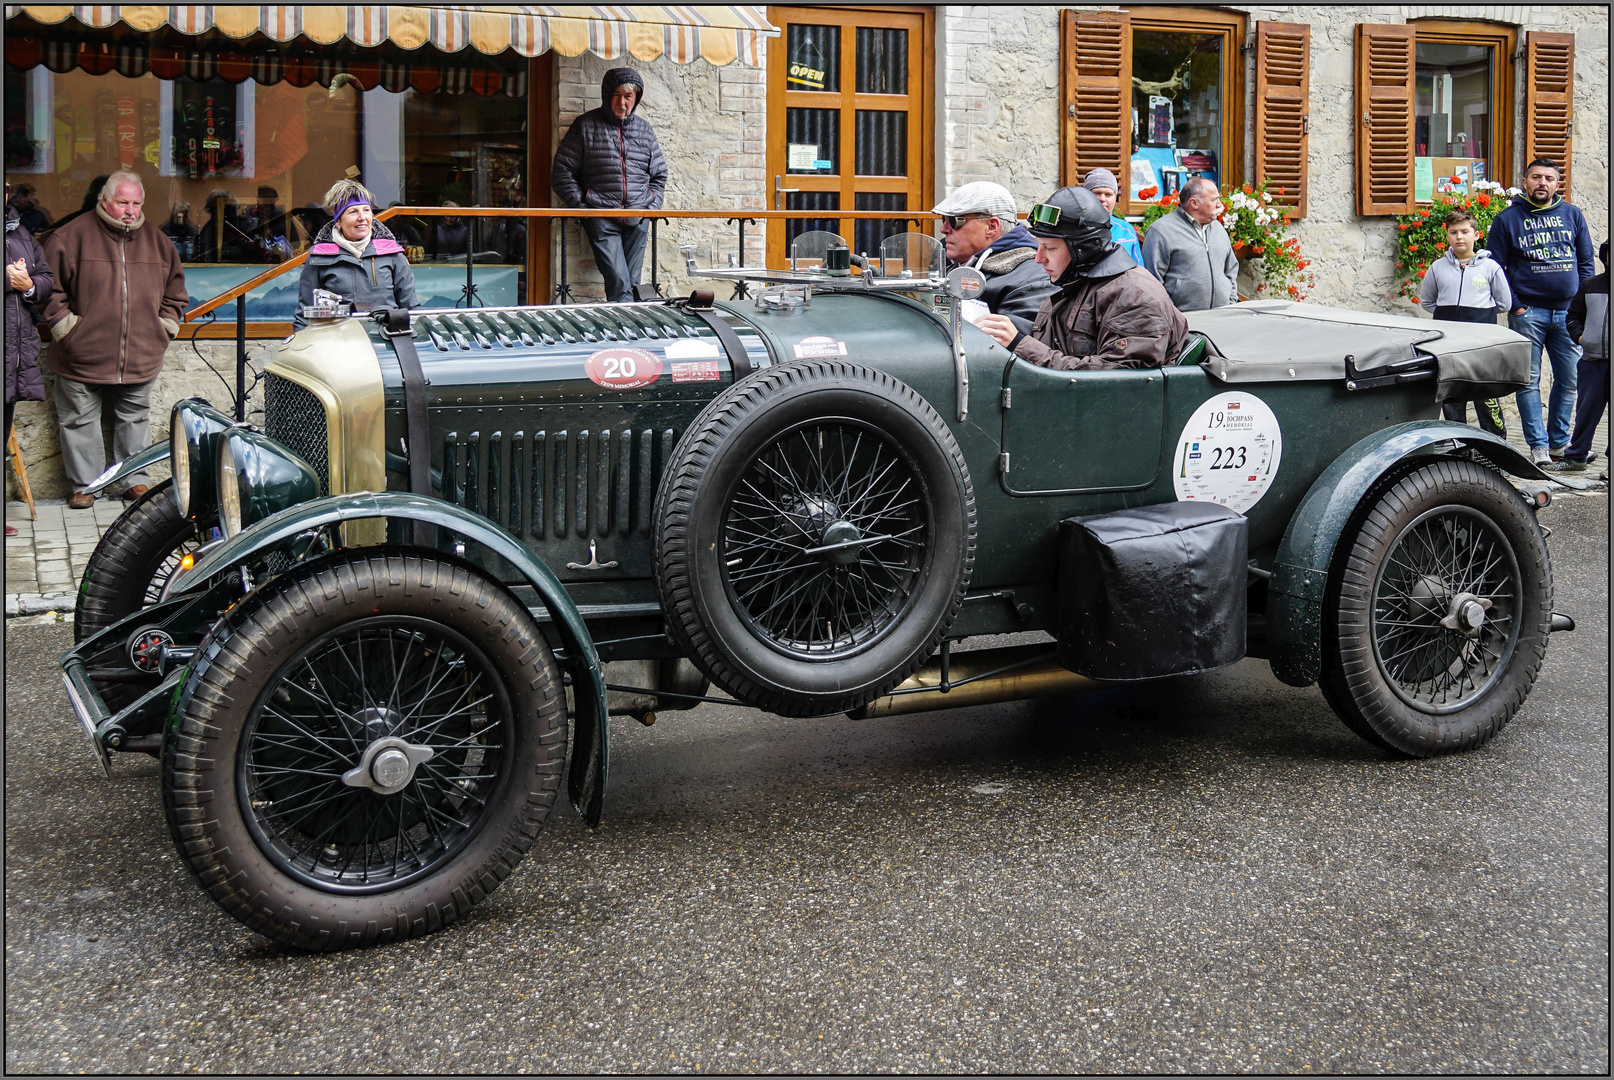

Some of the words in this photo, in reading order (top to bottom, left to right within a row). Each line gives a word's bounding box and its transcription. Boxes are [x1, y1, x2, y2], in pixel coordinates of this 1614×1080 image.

[790, 65, 825, 81] OPEN
[1523, 216, 1564, 230] CHANGE
[1518, 230, 1572, 249] MENTALITY
[603, 356, 637, 379] 20
[1207, 411, 1226, 428] 19.
[1226, 415, 1254, 423] JOCHPASS
[1209, 446, 1247, 470] 223
